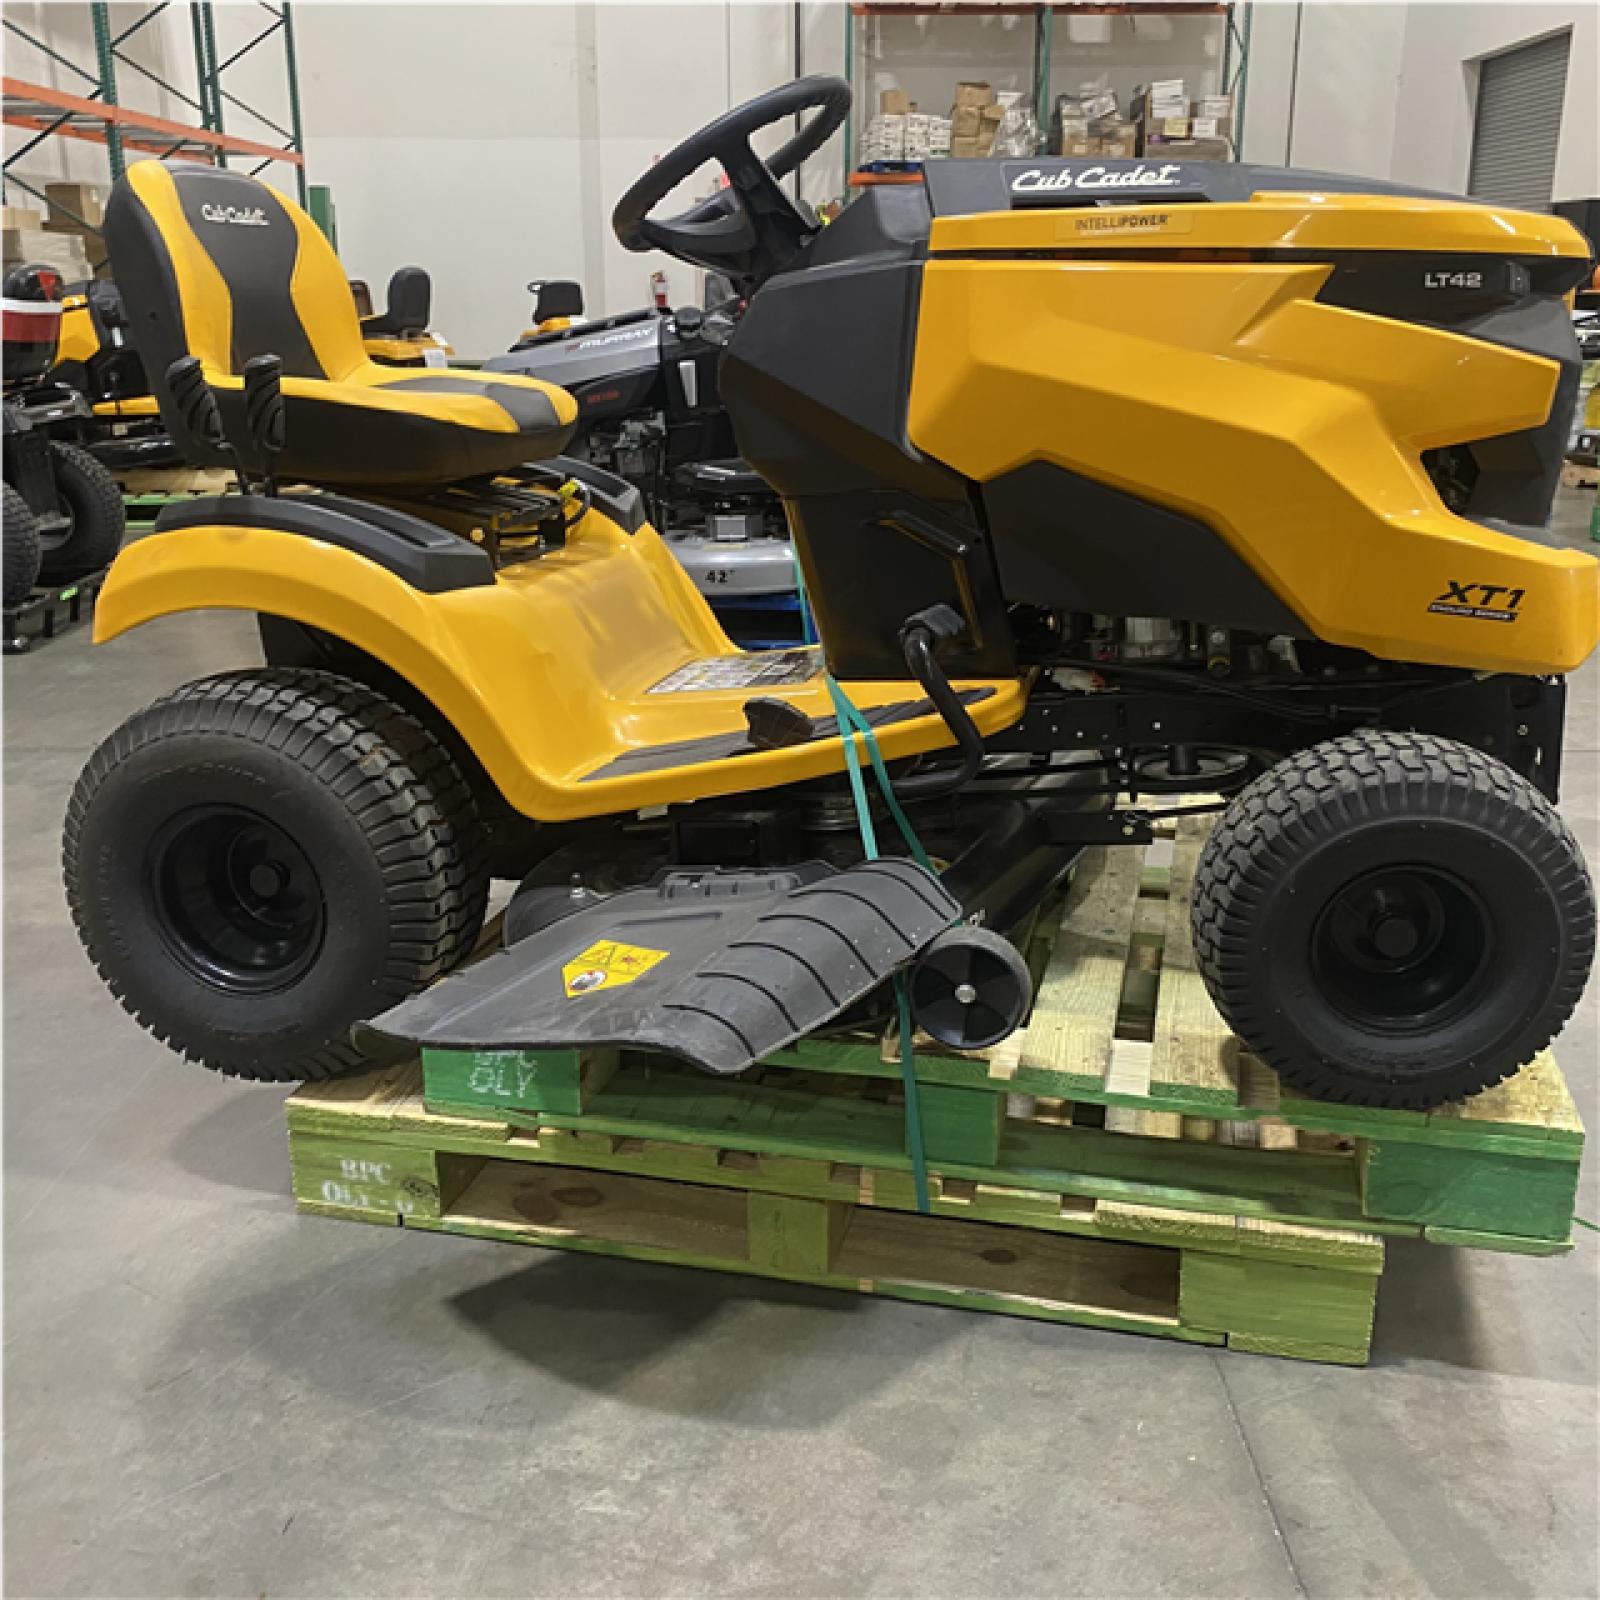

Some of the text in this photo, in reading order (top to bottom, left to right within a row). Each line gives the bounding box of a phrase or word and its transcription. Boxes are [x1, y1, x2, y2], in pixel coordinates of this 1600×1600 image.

[1012, 164, 1181, 191] Cub Cadet
[1075, 214, 1169, 231] INTELLIPOWER
[1424, 271, 1482, 288] LT42
[1434, 579, 1526, 608] XT1
